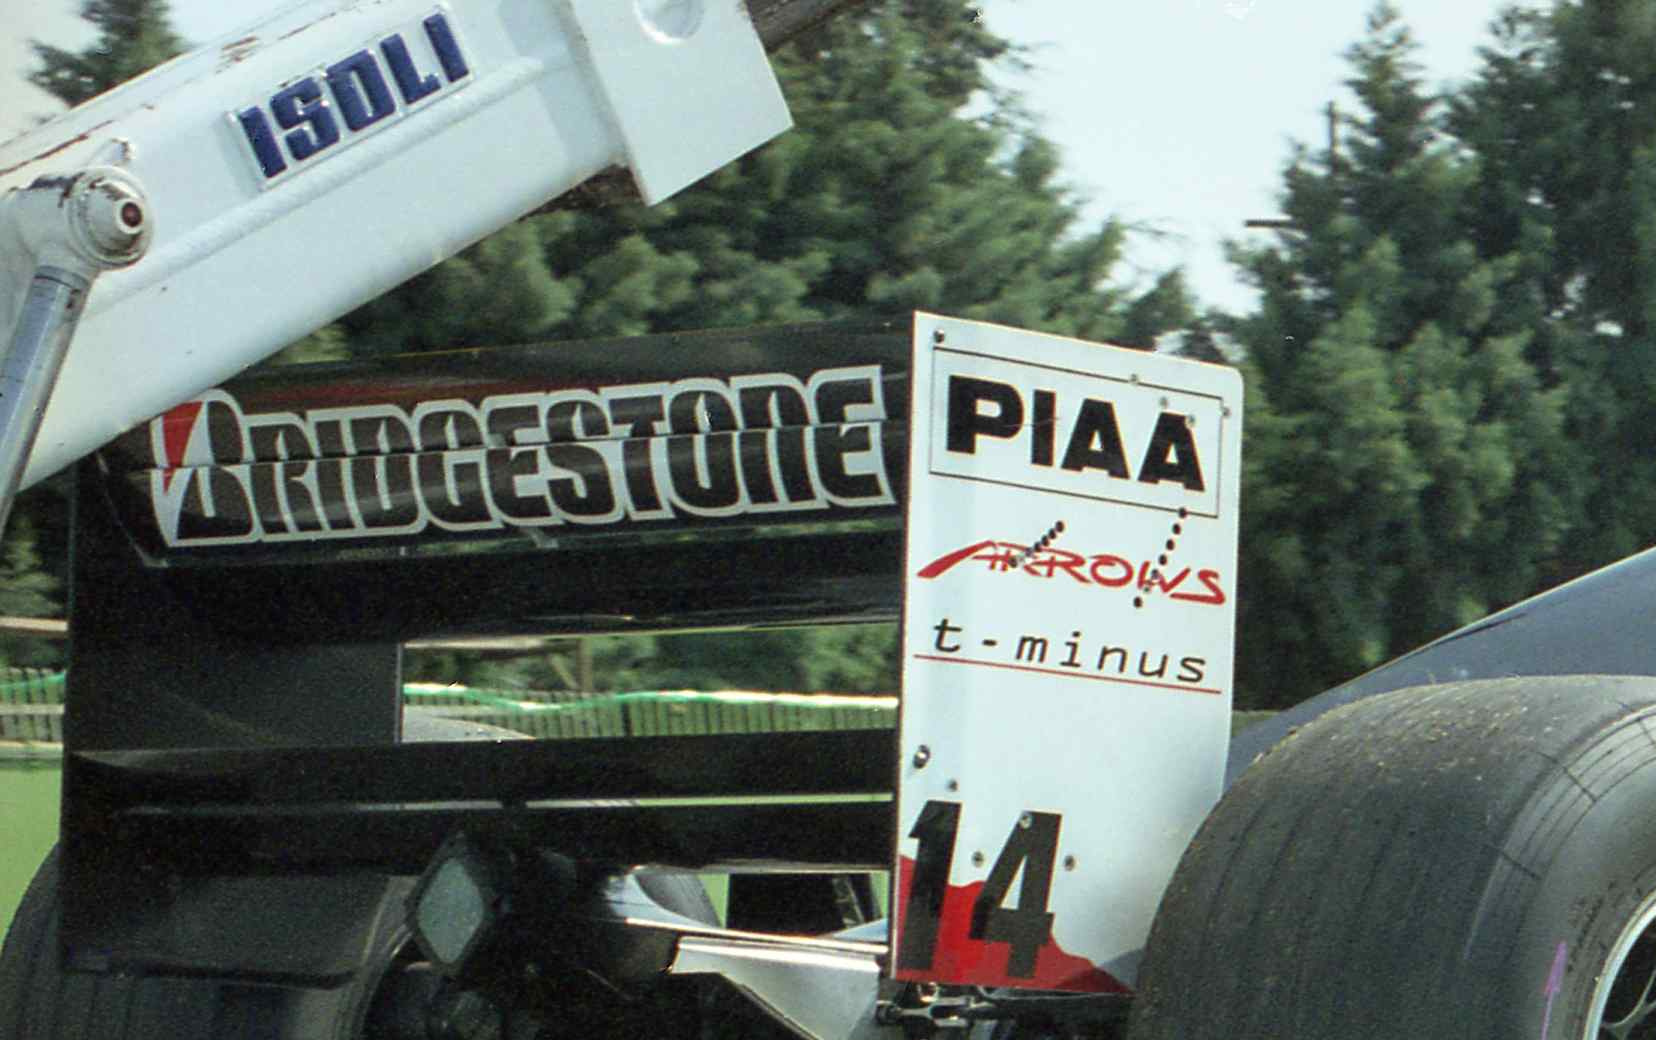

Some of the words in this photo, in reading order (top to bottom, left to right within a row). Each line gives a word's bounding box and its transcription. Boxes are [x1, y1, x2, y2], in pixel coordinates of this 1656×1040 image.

[240, 13, 470, 180] ISOLI
[151, 364, 898, 549] BRIDGESTONE
[945, 373, 1207, 493] PIAA
[916, 540, 1227, 606] ARROWS
[898, 799, 1063, 980] 14
